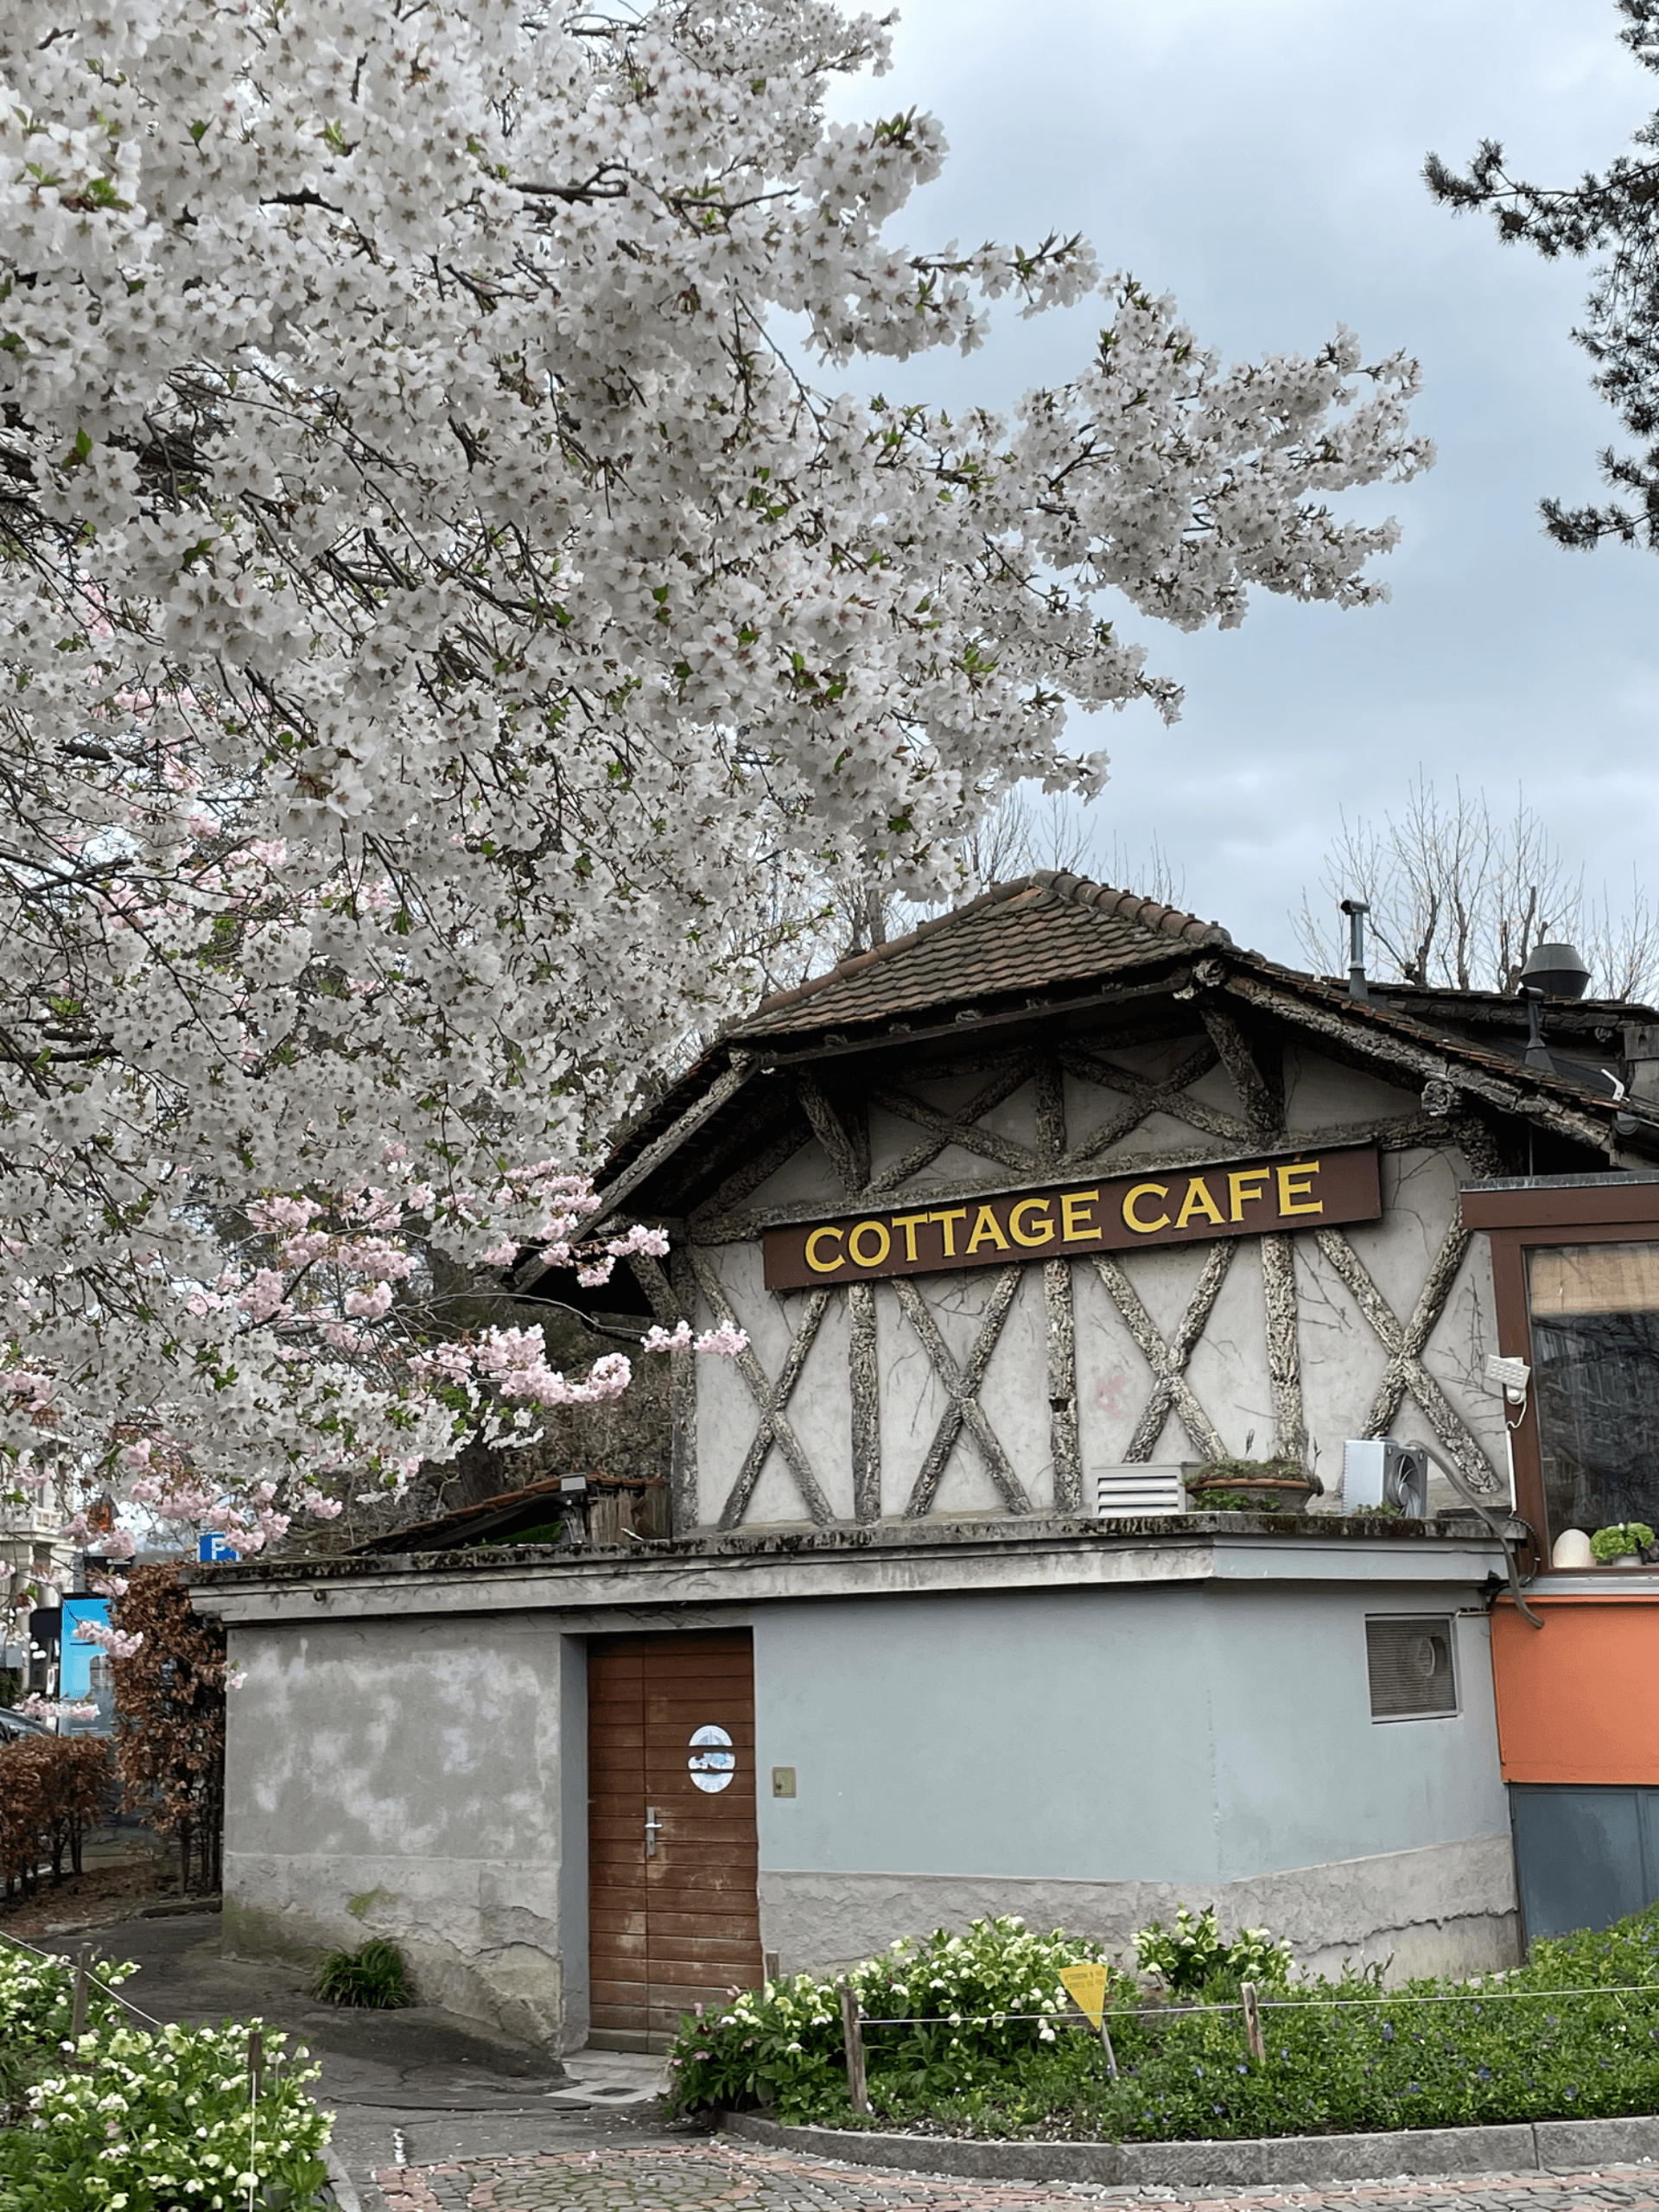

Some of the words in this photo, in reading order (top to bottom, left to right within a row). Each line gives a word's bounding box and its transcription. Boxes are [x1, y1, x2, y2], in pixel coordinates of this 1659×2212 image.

[804, 1190, 1103, 1272] COTTAGE
[1122, 1161, 1324, 1233] CAFE
[211, 1537, 226, 1560] P
